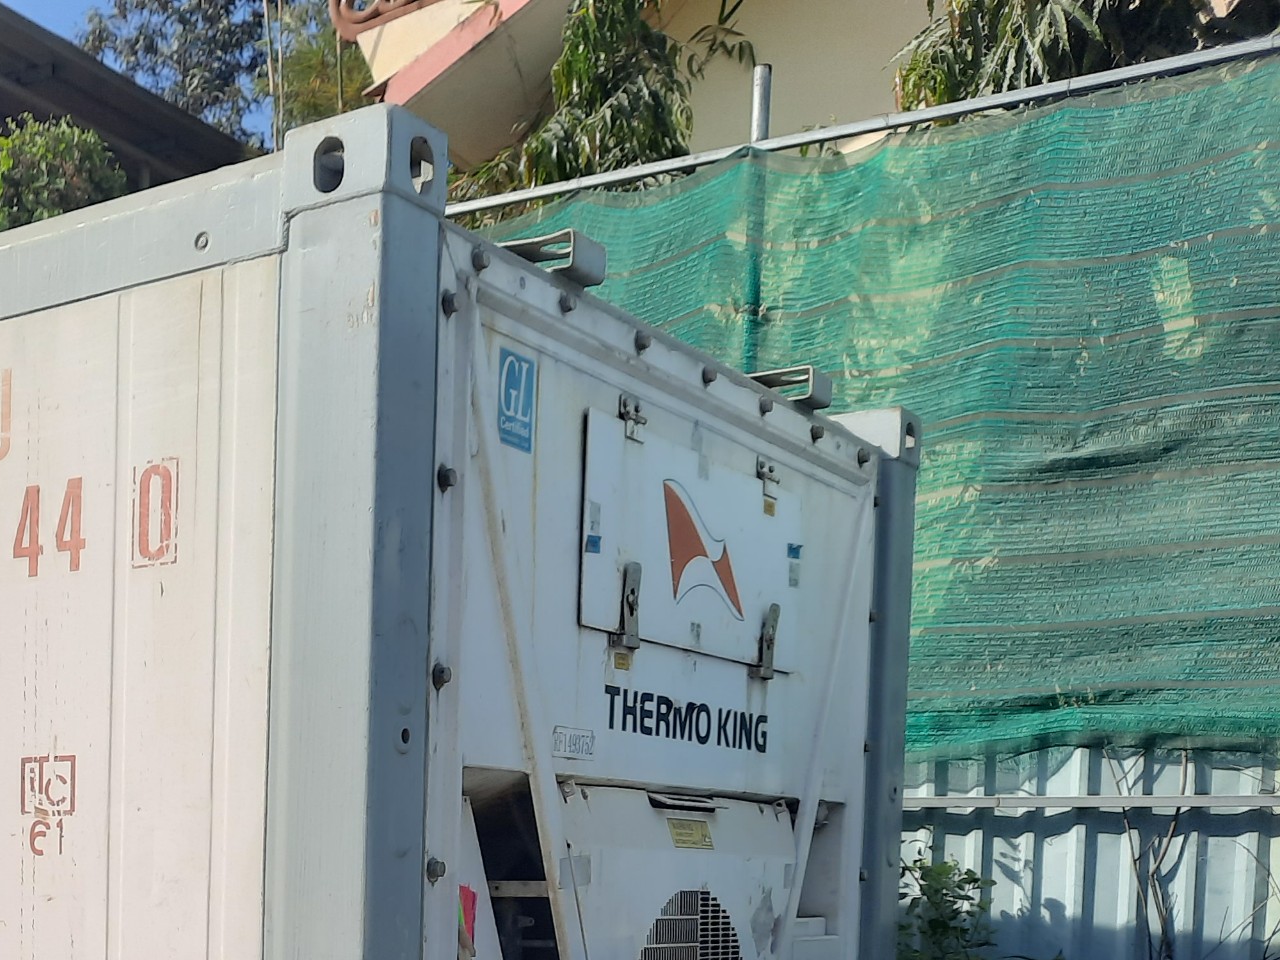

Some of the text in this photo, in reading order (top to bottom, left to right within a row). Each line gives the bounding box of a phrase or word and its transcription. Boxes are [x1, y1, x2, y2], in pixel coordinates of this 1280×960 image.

[501, 355, 529, 423] GL
[138, 463, 173, 561] 0
[605, 684, 769, 753] THERMO KING
